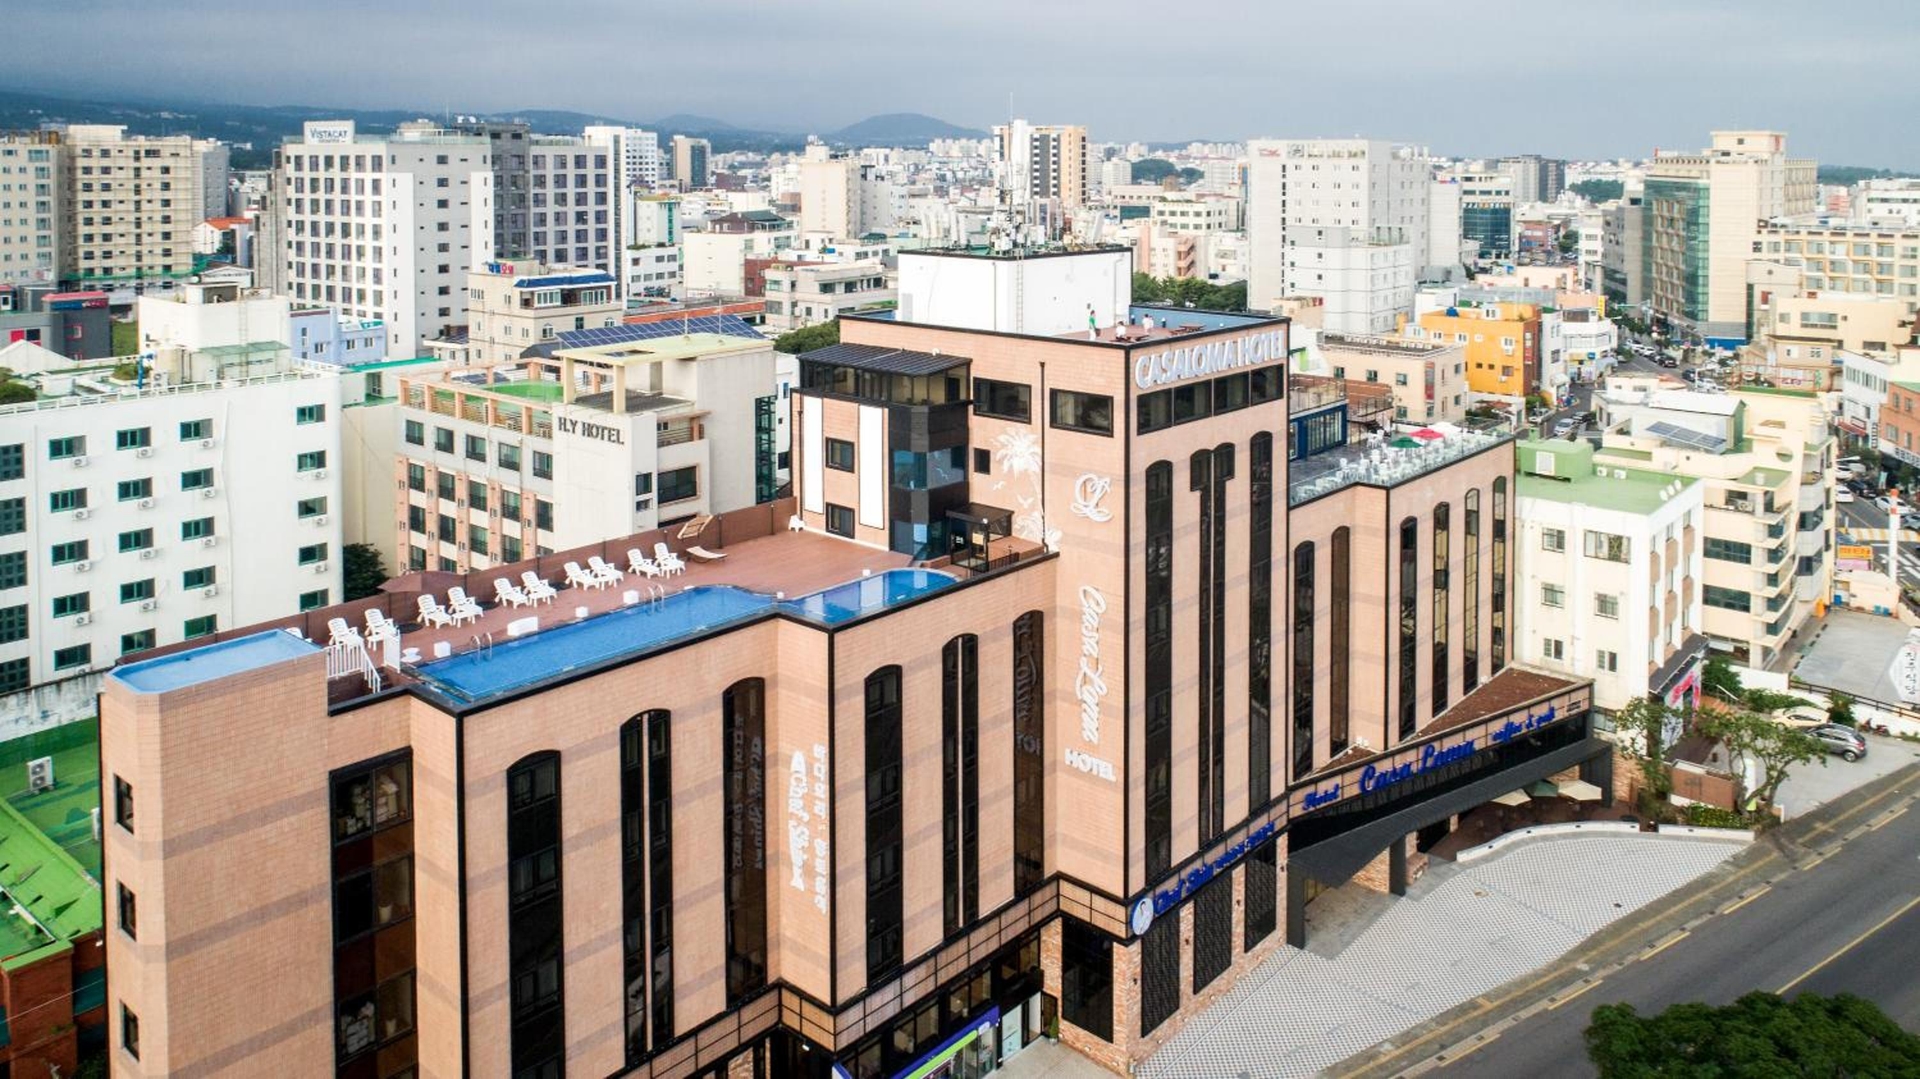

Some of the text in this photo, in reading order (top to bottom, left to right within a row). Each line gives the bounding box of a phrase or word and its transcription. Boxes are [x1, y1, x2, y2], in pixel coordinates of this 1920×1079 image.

[1136, 330, 1285, 389] CASALOMA HOTEL
[581, 421, 625, 445] HOTEL
[1075, 584, 1108, 745] Casa Loma
[1065, 747, 1117, 782] HOTEL
[1358, 762, 1413, 794] Casa
[1418, 740, 1475, 775] Loma
